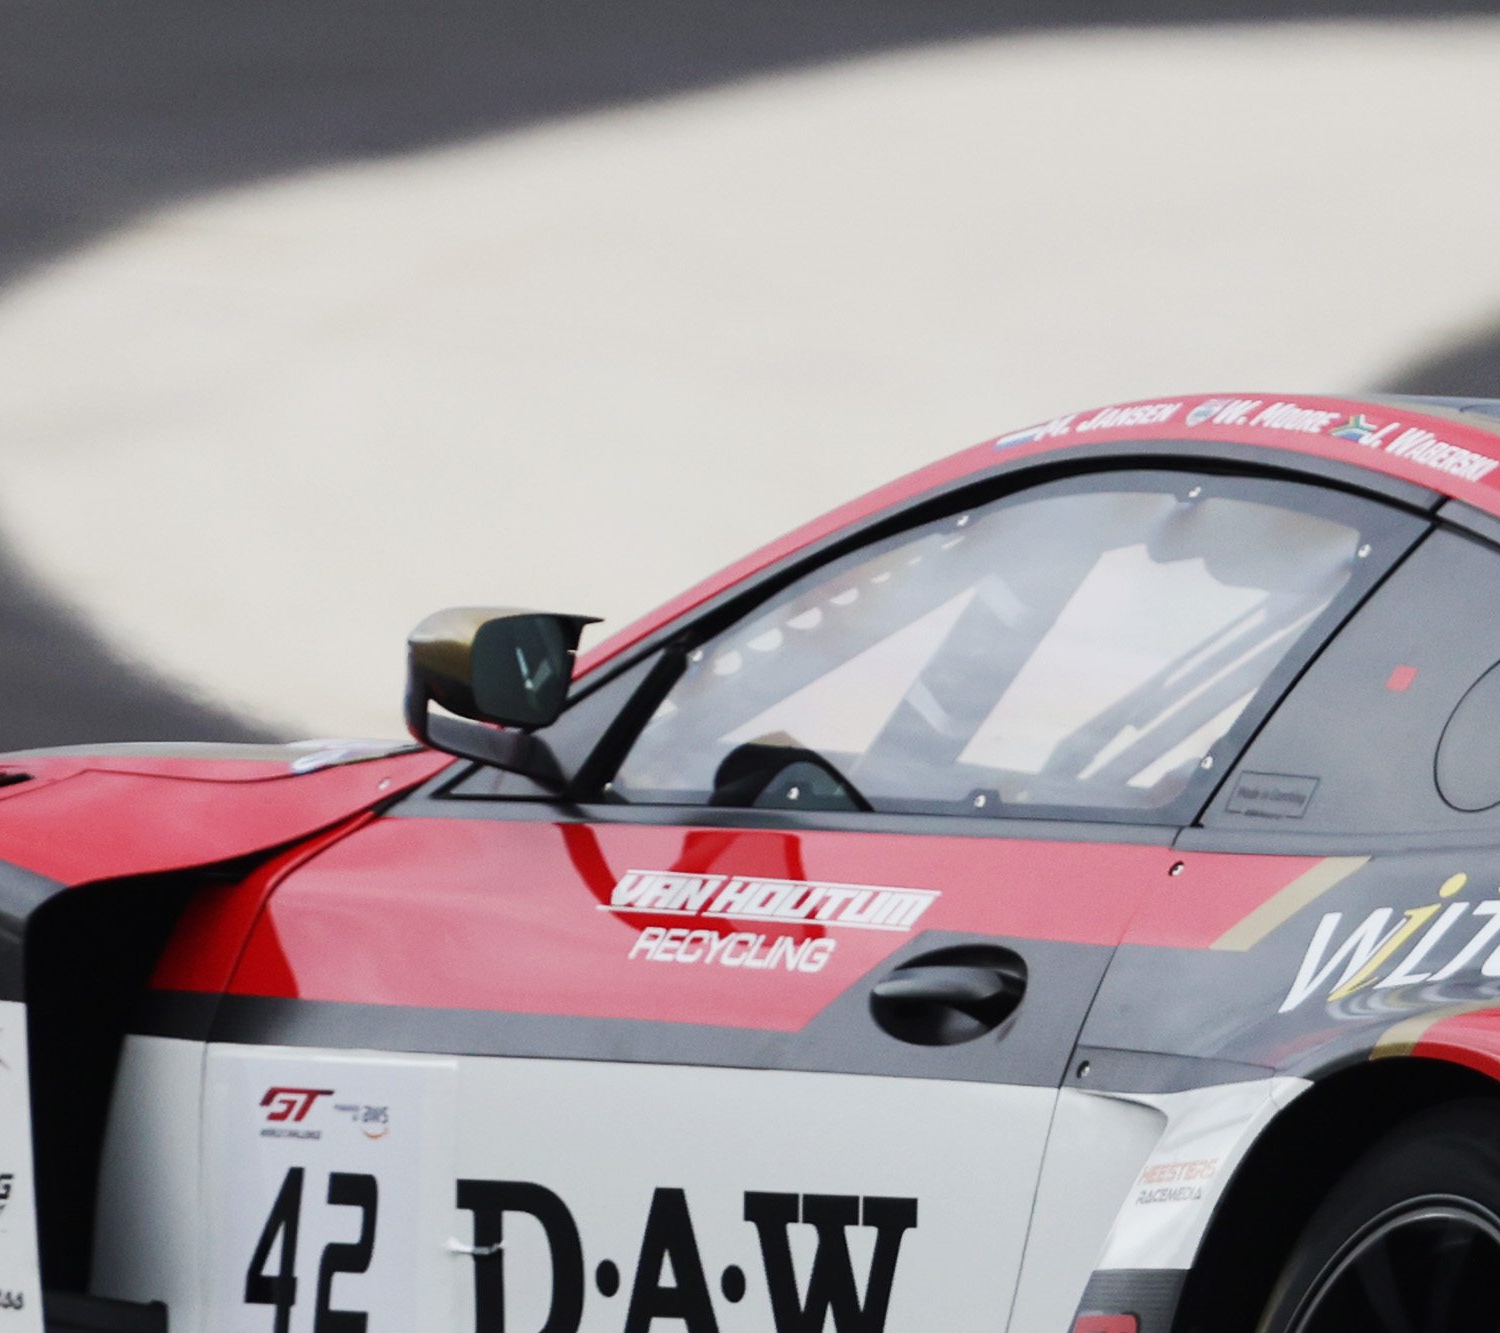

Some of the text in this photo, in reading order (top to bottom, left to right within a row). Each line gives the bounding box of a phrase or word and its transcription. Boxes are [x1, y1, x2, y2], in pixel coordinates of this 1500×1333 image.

[1076, 402, 1183, 432] JANSEN
[610, 872, 938, 928] VAN HOUTUM
[629, 927, 836, 972] RECYCLING
[259, 1087, 335, 1121] GT
